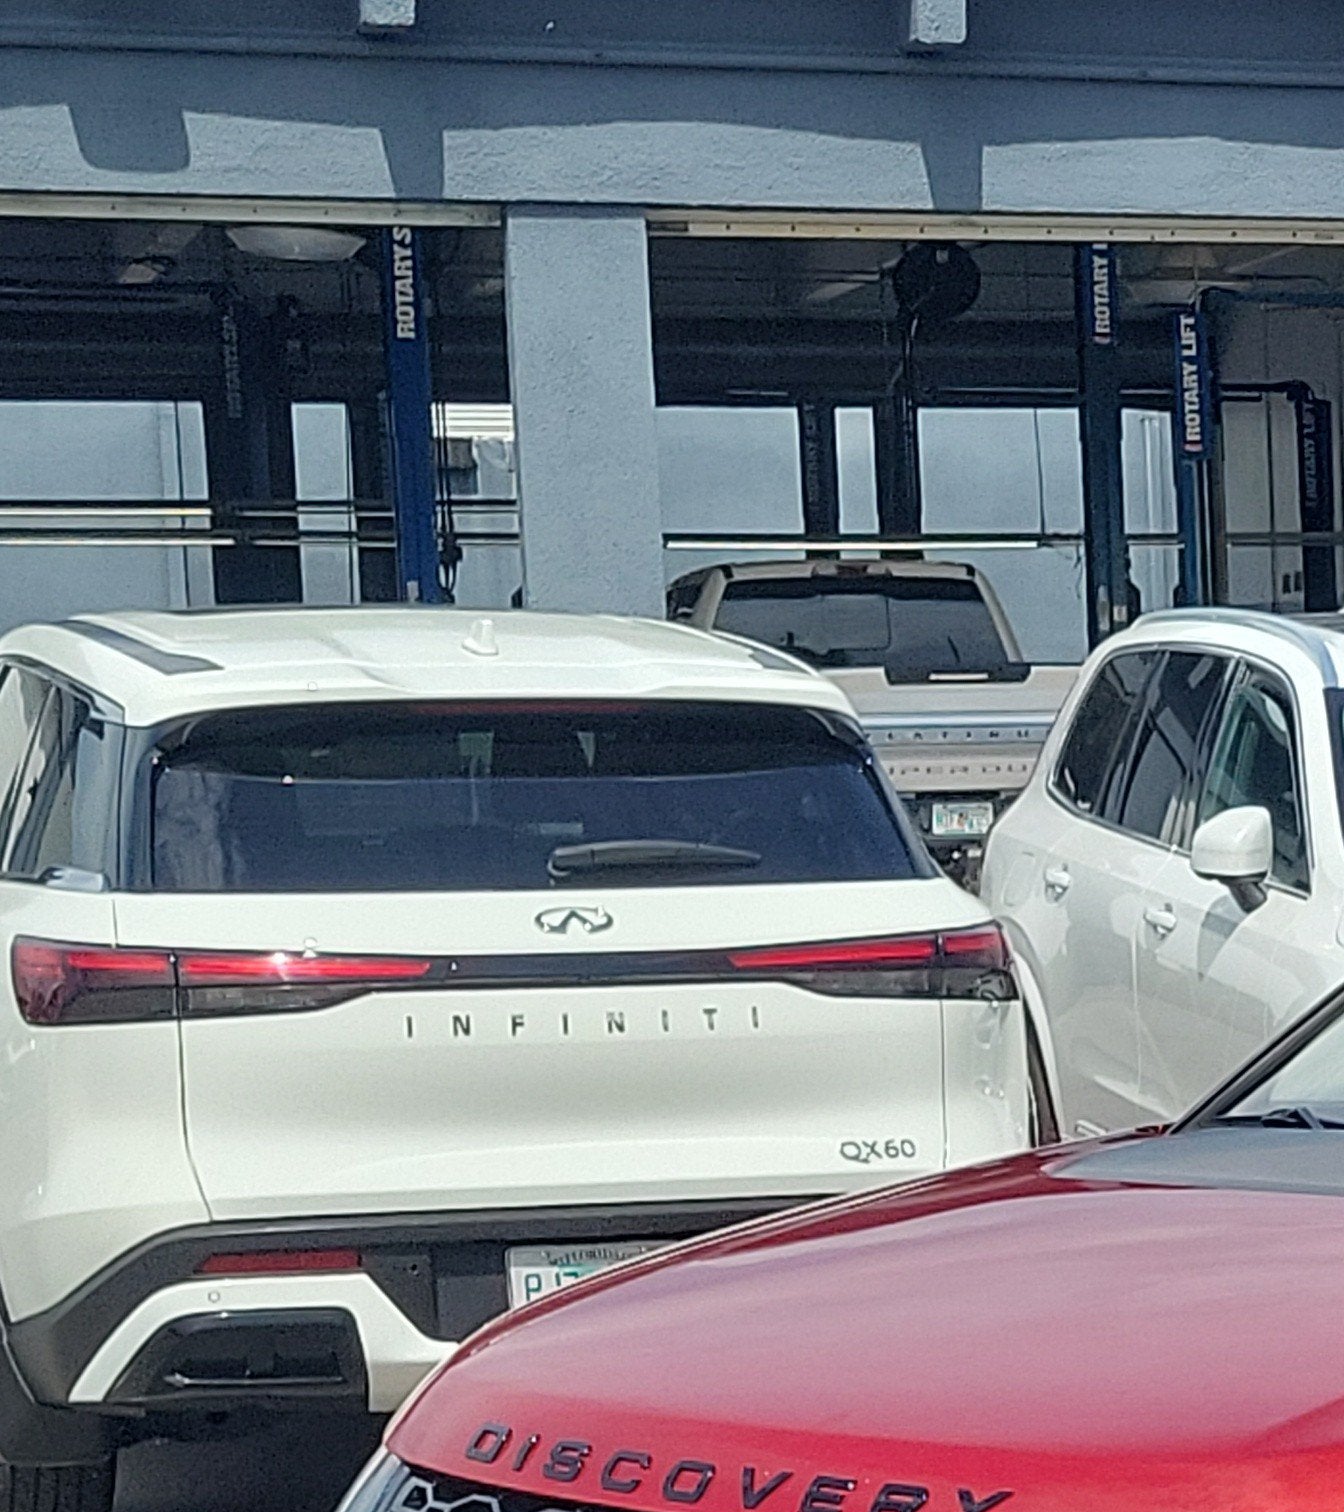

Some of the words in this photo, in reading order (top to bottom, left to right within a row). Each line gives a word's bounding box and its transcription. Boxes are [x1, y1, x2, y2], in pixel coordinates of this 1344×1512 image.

[1092, 255, 1110, 333] ROTARY
[1180, 314, 1197, 356] LIFT
[1182, 361, 1202, 442] ROTARY
[406, 1005, 759, 1038] INFINITI
[839, 1139, 917, 1164] QX60
